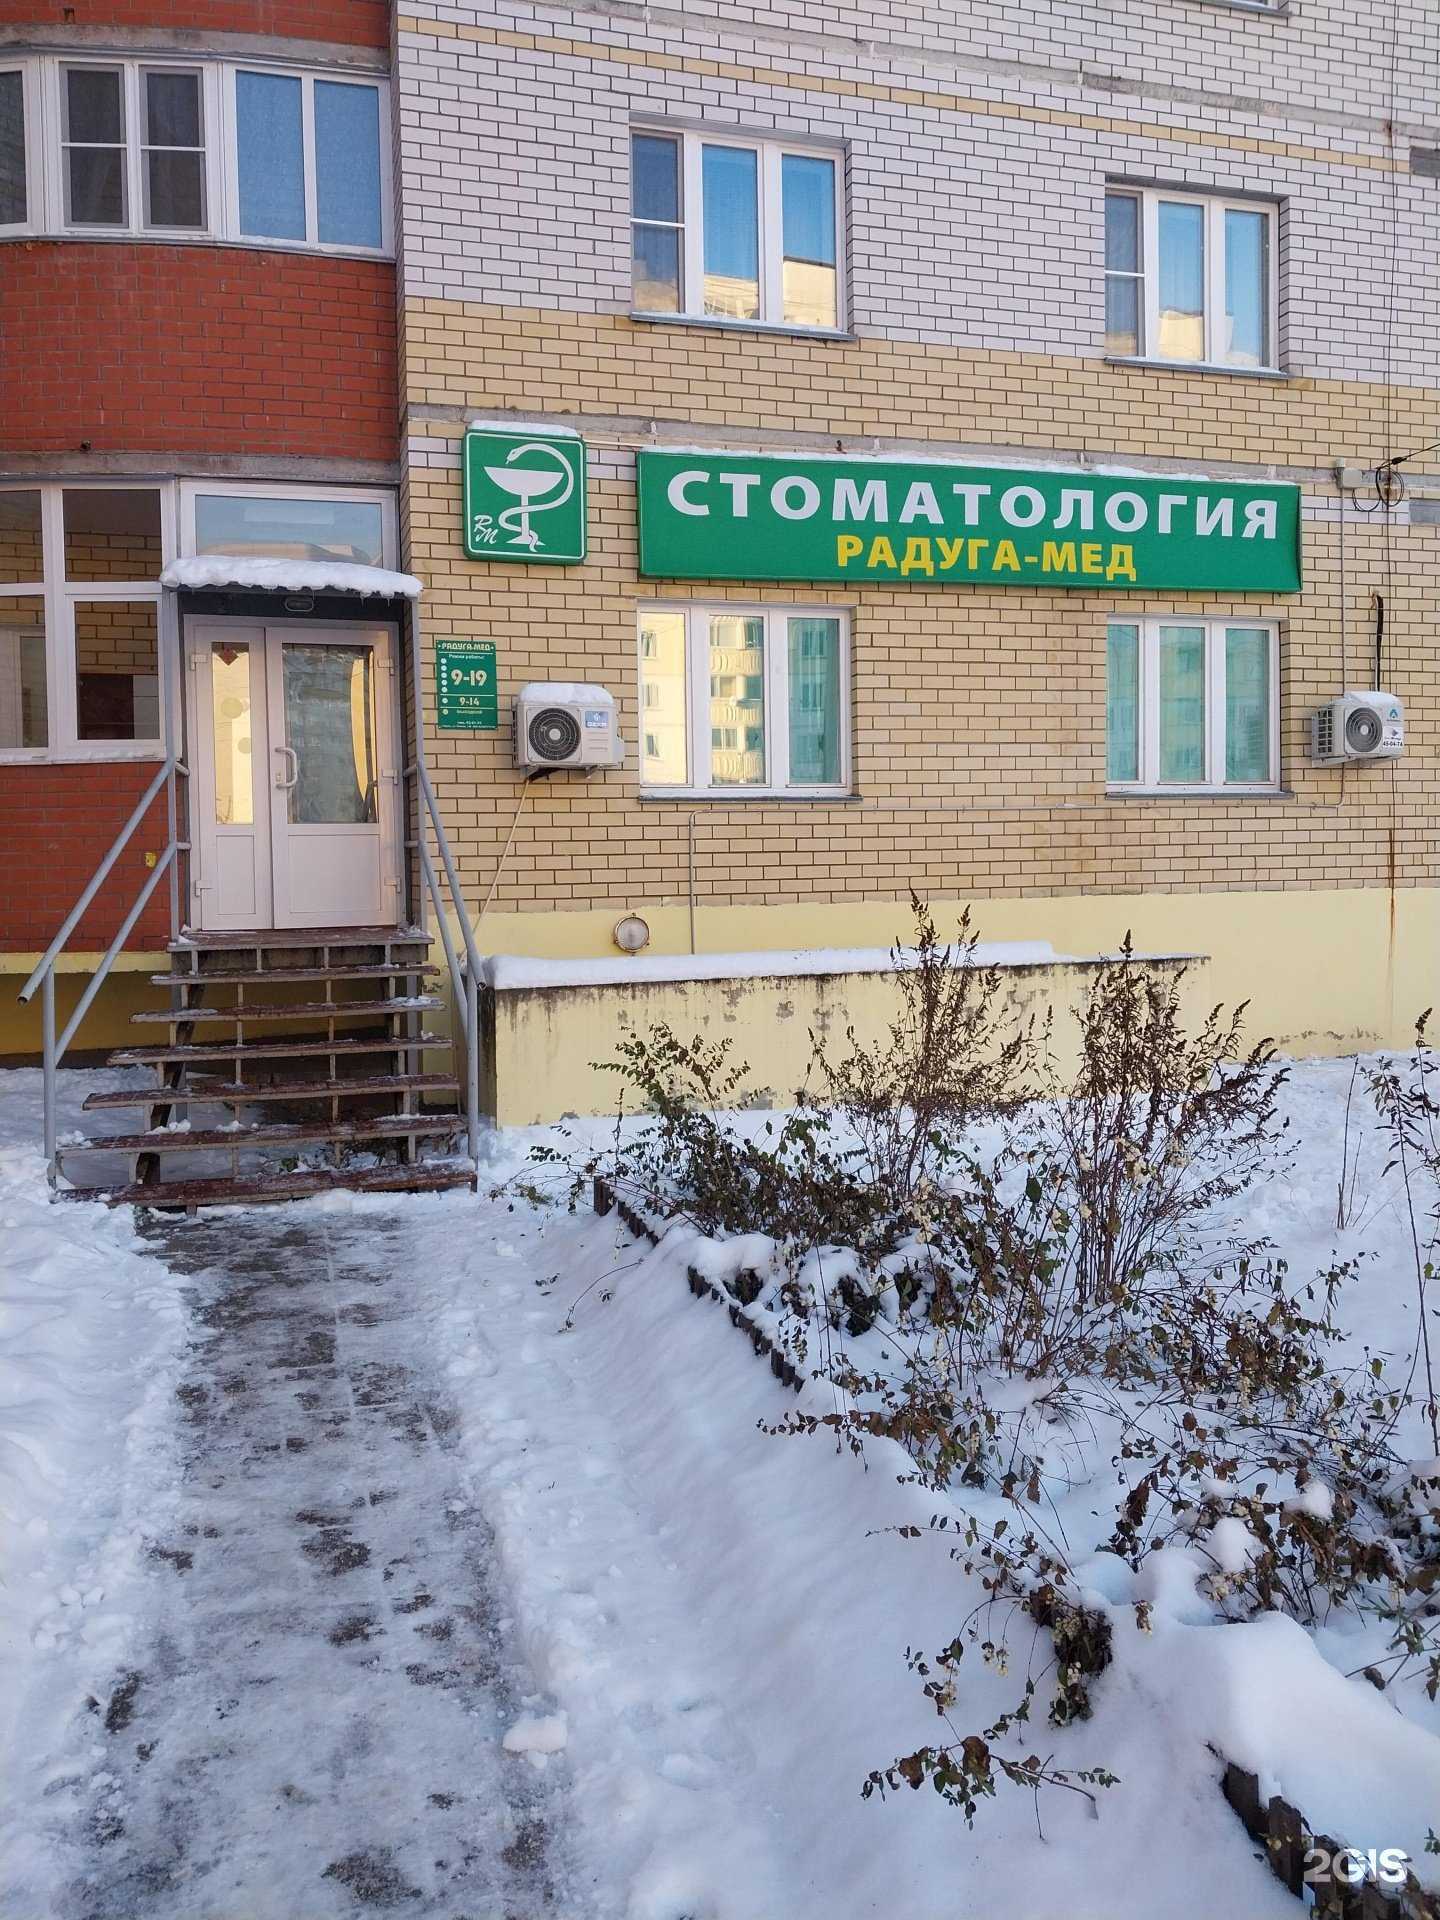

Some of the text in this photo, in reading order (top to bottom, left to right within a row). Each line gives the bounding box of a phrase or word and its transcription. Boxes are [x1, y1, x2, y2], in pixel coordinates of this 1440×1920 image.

[666, 470, 1278, 540] СТОМАТОЛОГИЯ
[836, 534, 1137, 582] РАДУГА-МЕД
[450, 669, 488, 686] 9-19
[459, 696, 480, 706] 9-14
